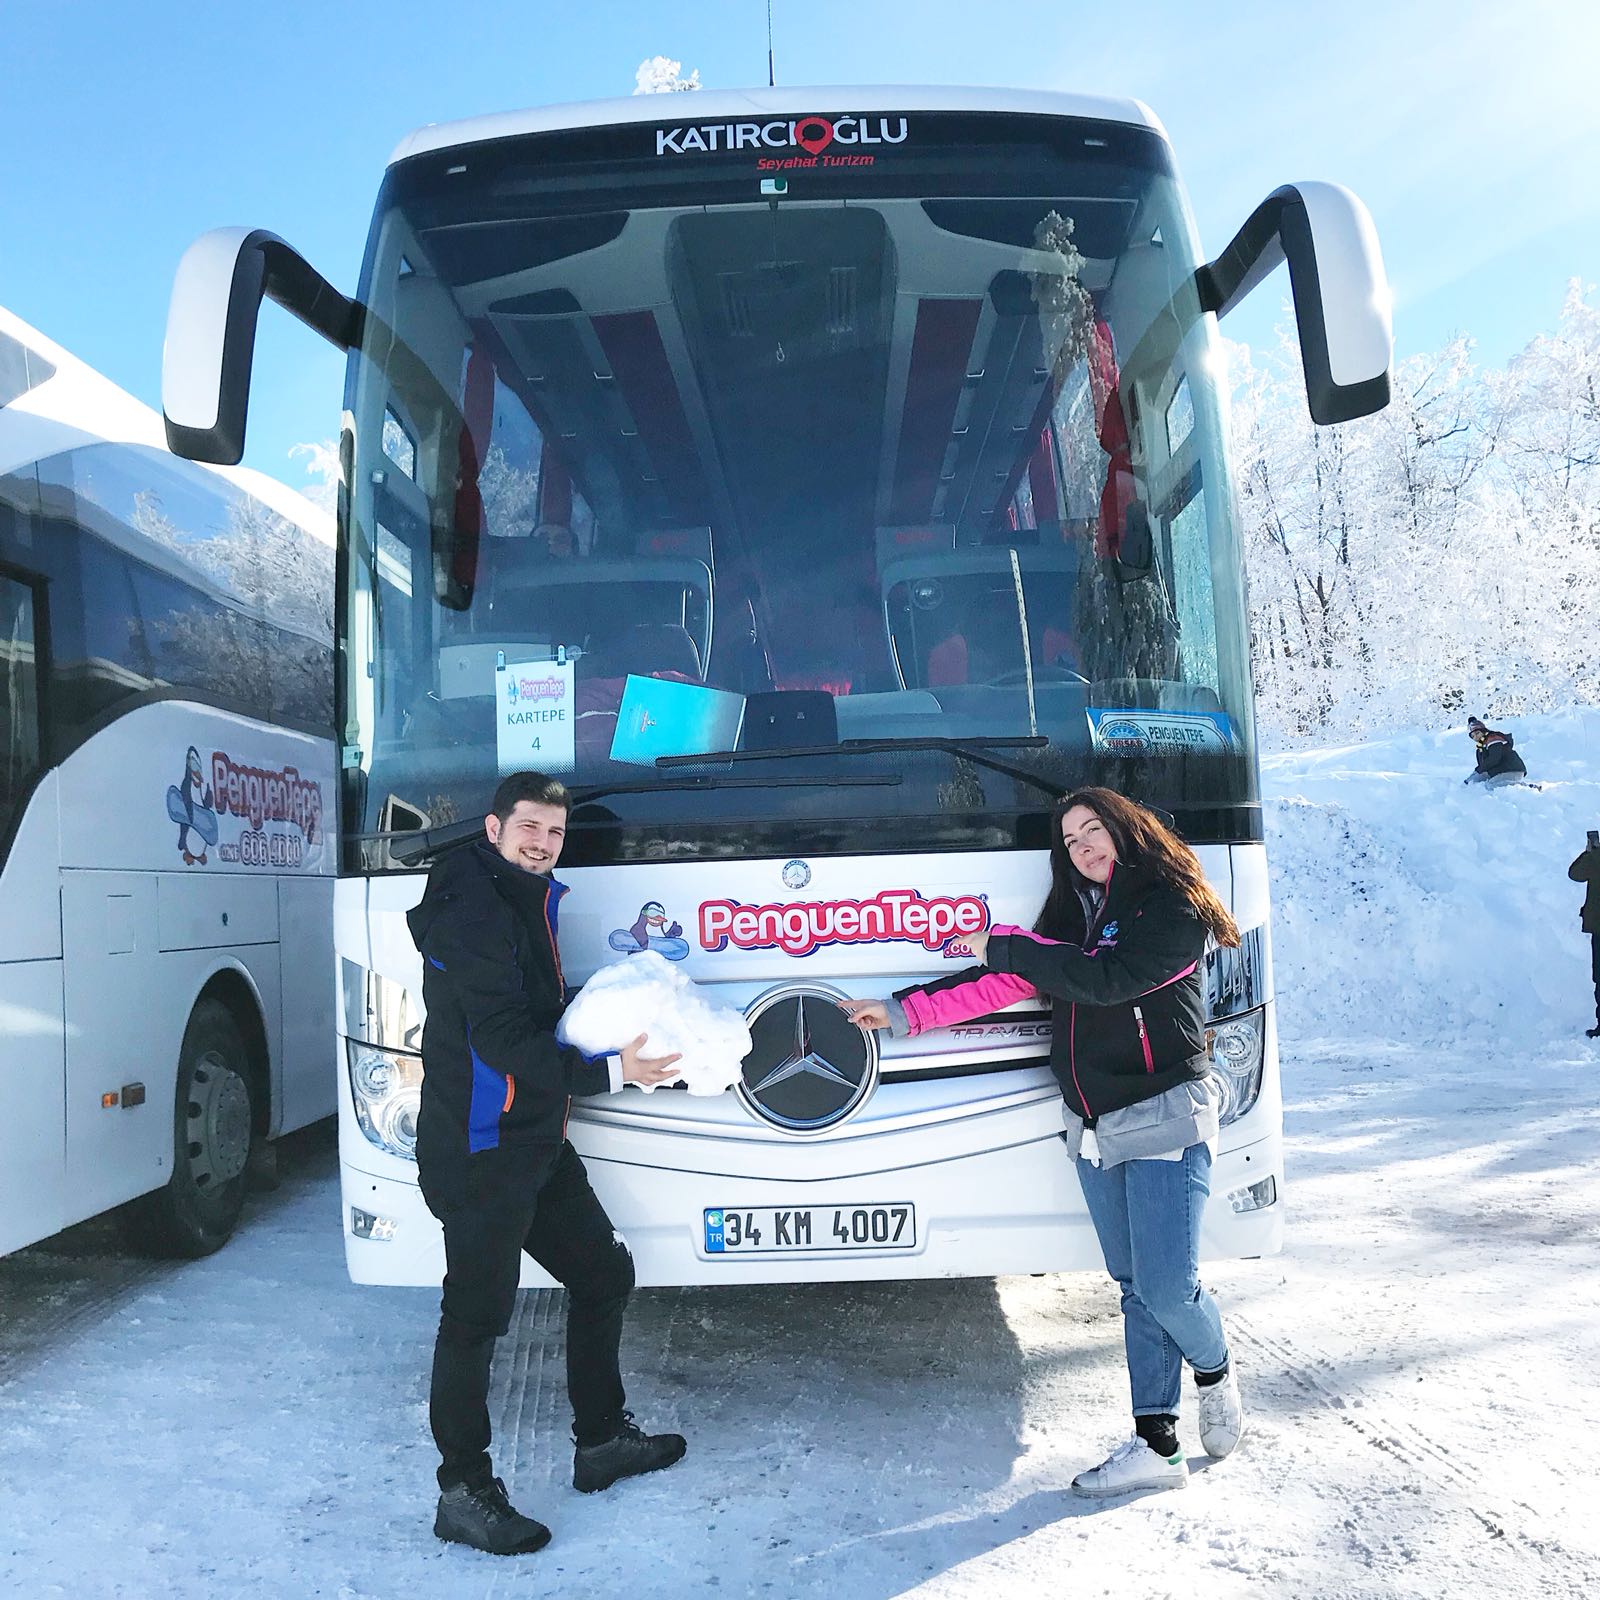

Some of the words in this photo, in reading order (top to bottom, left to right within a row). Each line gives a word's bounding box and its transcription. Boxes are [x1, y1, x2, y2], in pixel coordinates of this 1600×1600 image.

[656, 115, 908, 156] KATIRCIOĞLU
[757, 156, 818, 171] Seyahat
[822, 154, 875, 167] Turizm
[507, 709, 565, 725] KARTEPE
[1148, 726, 1186, 740] PENGUEN
[1185, 728, 1205, 742] TEPE
[531, 736, 541, 751] 4
[213, 752, 322, 831] PenguenTepe
[241, 832, 267, 866] 606
[701, 891, 985, 953] PenguenTepe
[944, 942, 975, 957] .co
[950, 1024, 1053, 1040] TRAVEG
[725, 1213, 761, 1246] 34
[775, 1211, 811, 1245] KM
[833, 1208, 907, 1243] 4007
[709, 1232, 722, 1243] TR
